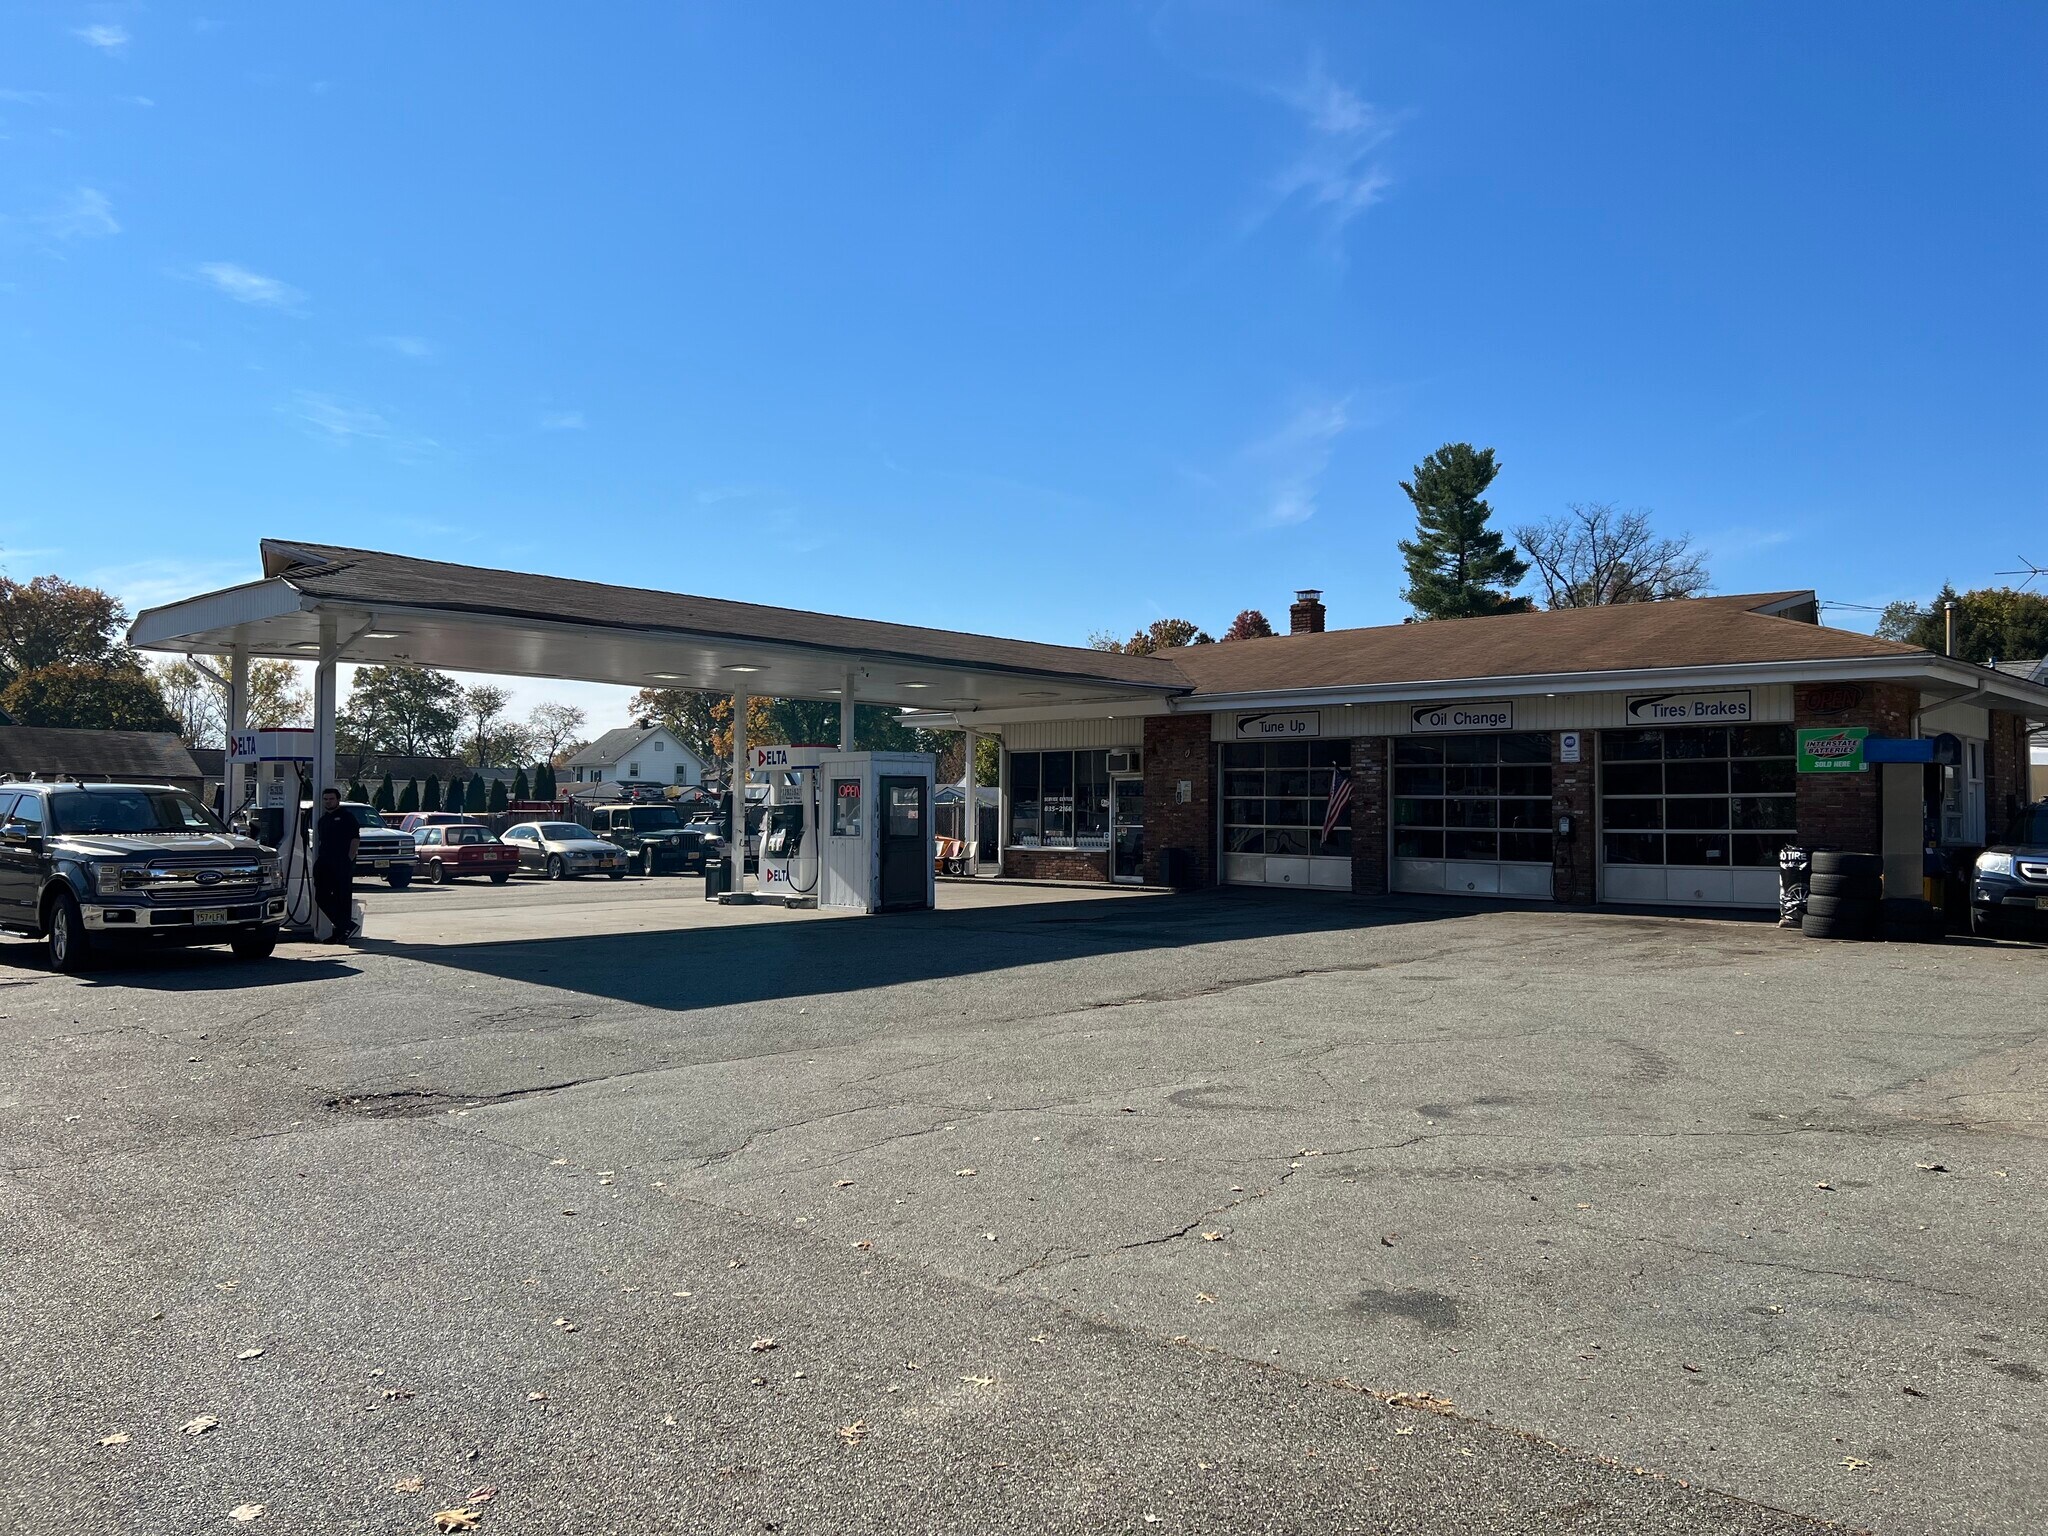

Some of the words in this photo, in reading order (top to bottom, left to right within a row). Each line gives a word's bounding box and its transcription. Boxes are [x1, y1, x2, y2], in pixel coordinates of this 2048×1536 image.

[1650, 700, 1747, 717] Tires/Brakes
[1259, 721, 1285, 733] Tune
[1290, 720, 1306, 733] Up
[1429, 711, 1447, 727] Oil
[1453, 711, 1507, 728] Change
[231, 735, 257, 758] DELTA
[758, 749, 788, 767] DELTA
[1833, 760, 1851, 768] HERE
[838, 785, 860, 798] OPEN
[1786, 851, 1807, 860] TIRE
